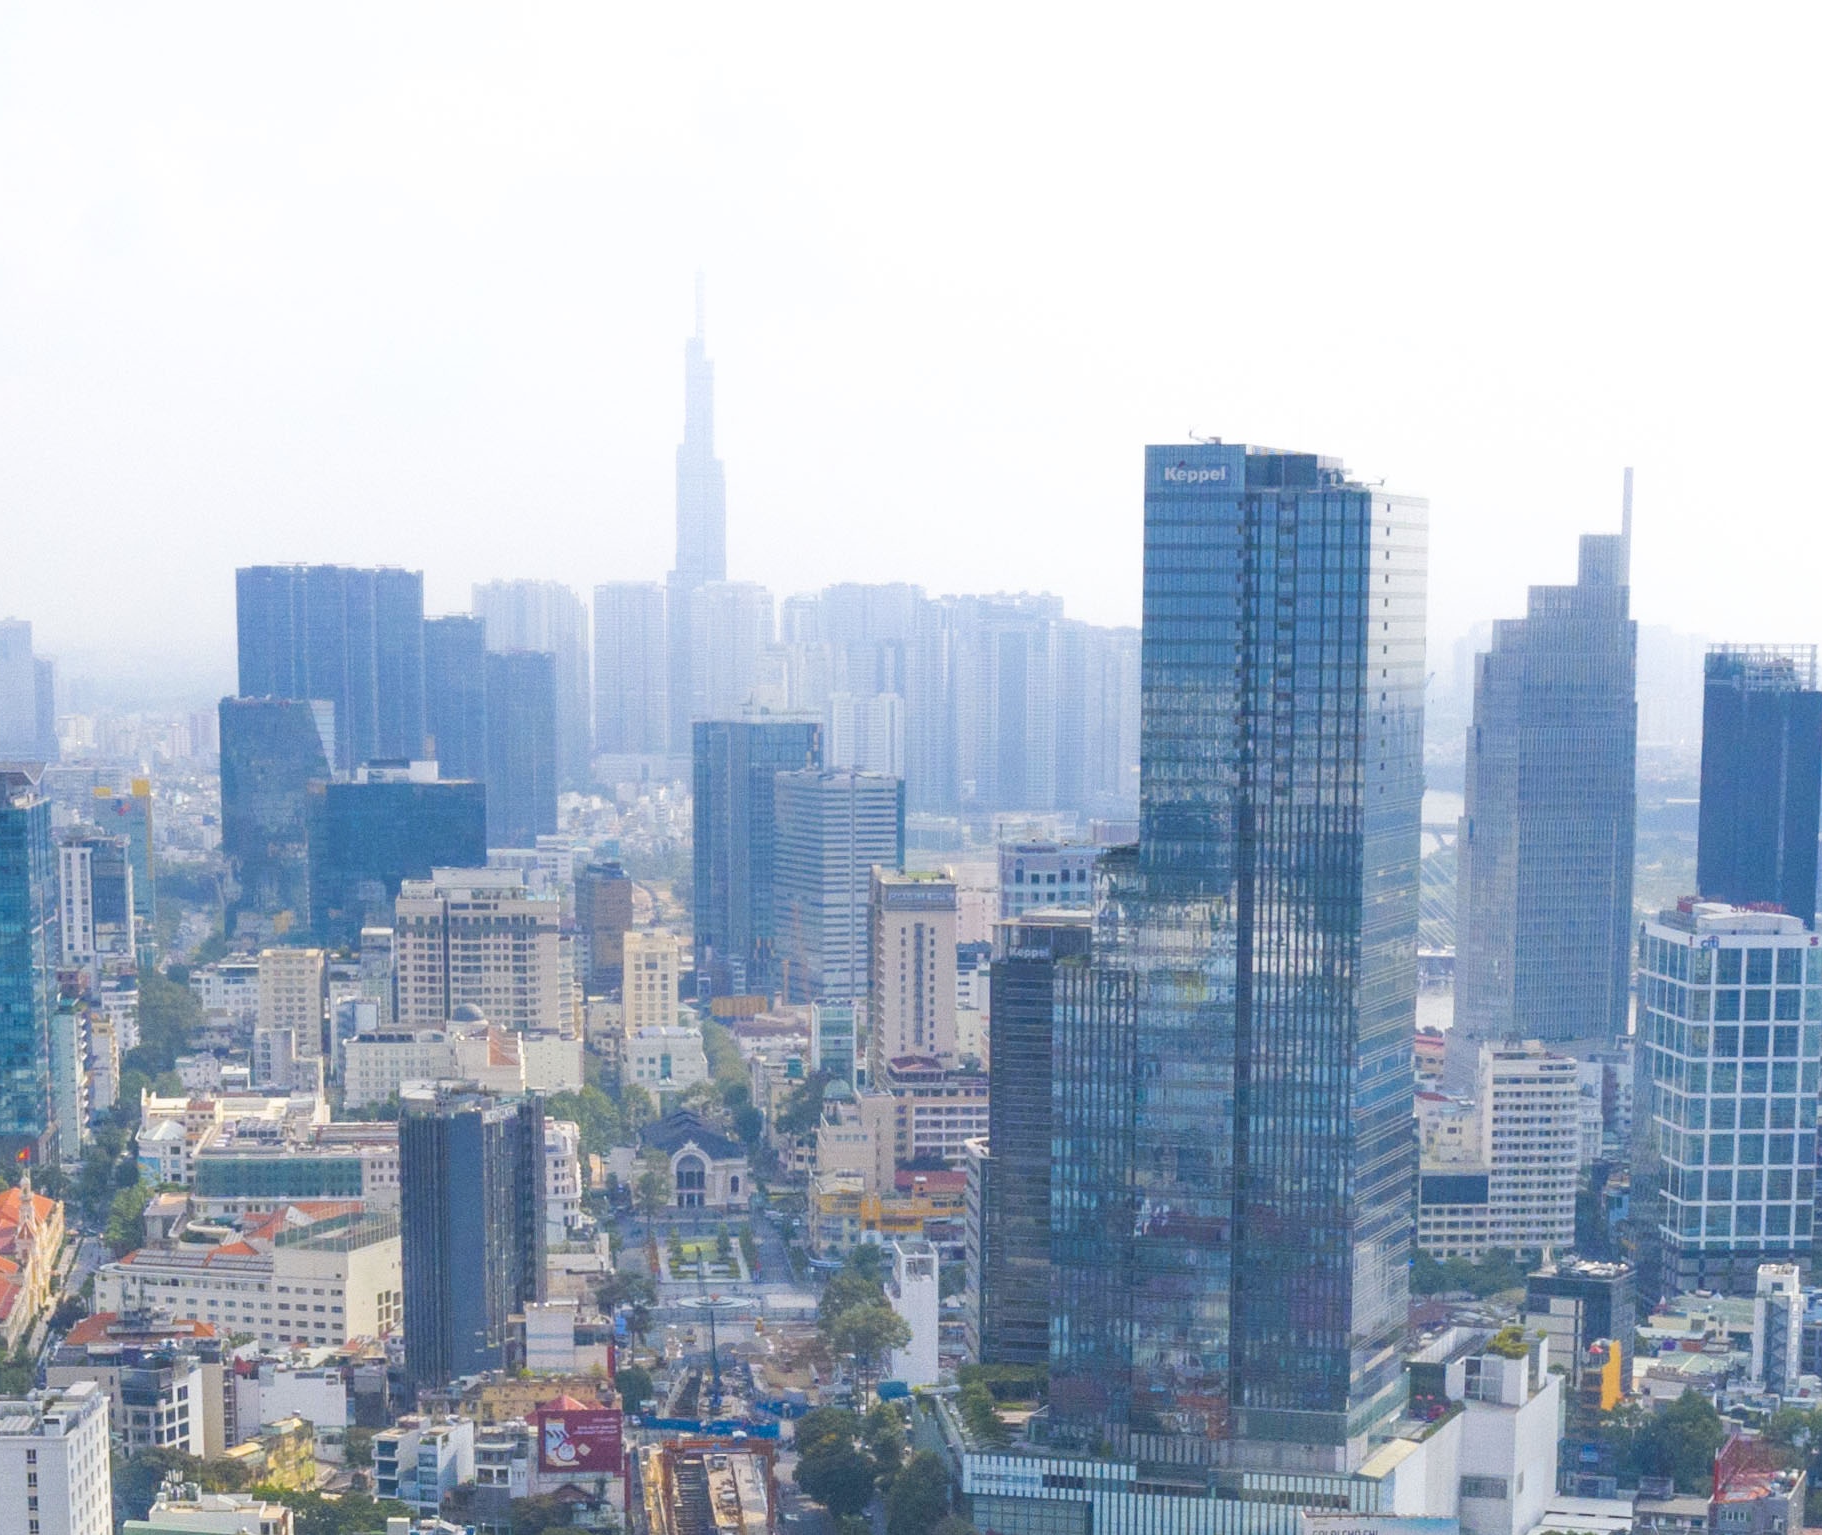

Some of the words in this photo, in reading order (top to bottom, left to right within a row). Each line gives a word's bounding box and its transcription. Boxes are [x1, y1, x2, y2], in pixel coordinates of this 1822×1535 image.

[1164, 464, 1226, 484] Keppel
[1700, 935, 1720, 949] citi
[1009, 946, 1051, 959] Keppel
